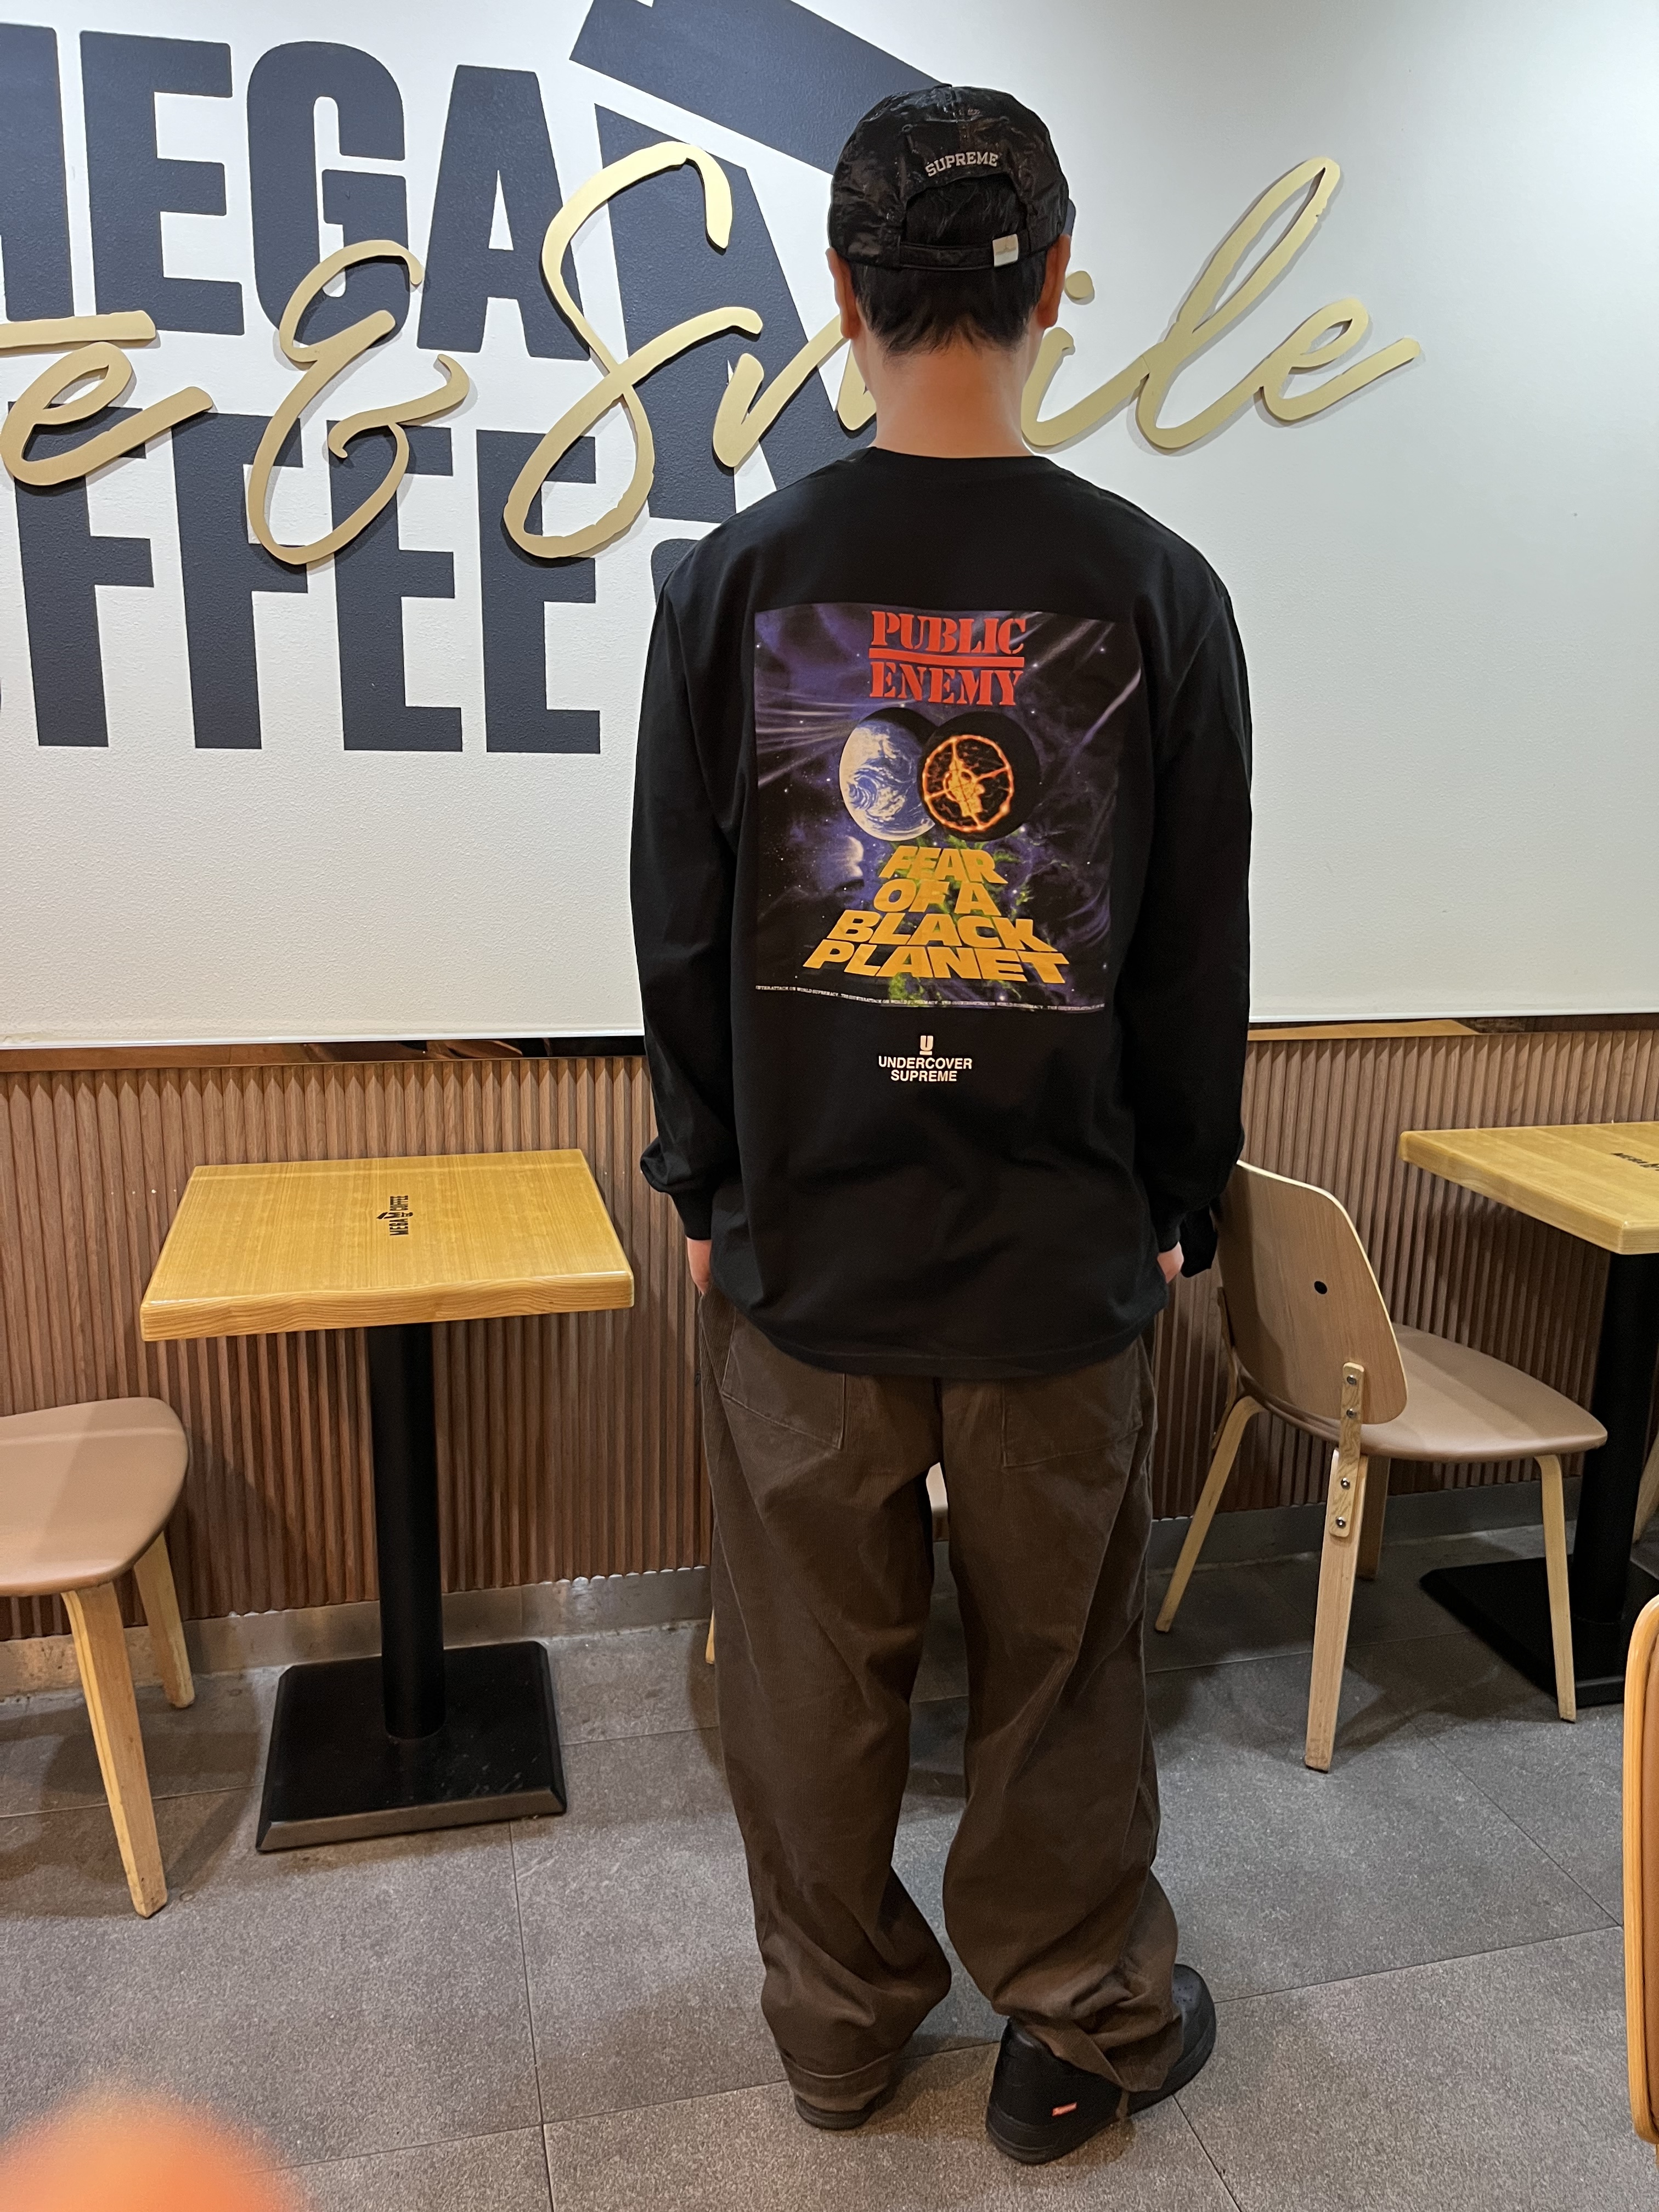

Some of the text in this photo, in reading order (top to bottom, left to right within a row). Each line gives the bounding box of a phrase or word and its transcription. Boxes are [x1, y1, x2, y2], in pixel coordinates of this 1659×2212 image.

[925, 151, 998, 177] SUPREME
[0, 402, 601, 754] FFEE
[871, 610, 1026, 654] PUBLIC
[869, 661, 1024, 707] ENEMY
[878, 845, 1008, 884] FEAR
[873, 878, 1002, 917] OF A
[826, 909, 1058, 952] BLACK
[802, 939, 1070, 984] PLANET
[878, 1056, 973, 1070] UNDERCOVER
[890, 1069, 957, 1082] SUPREME
